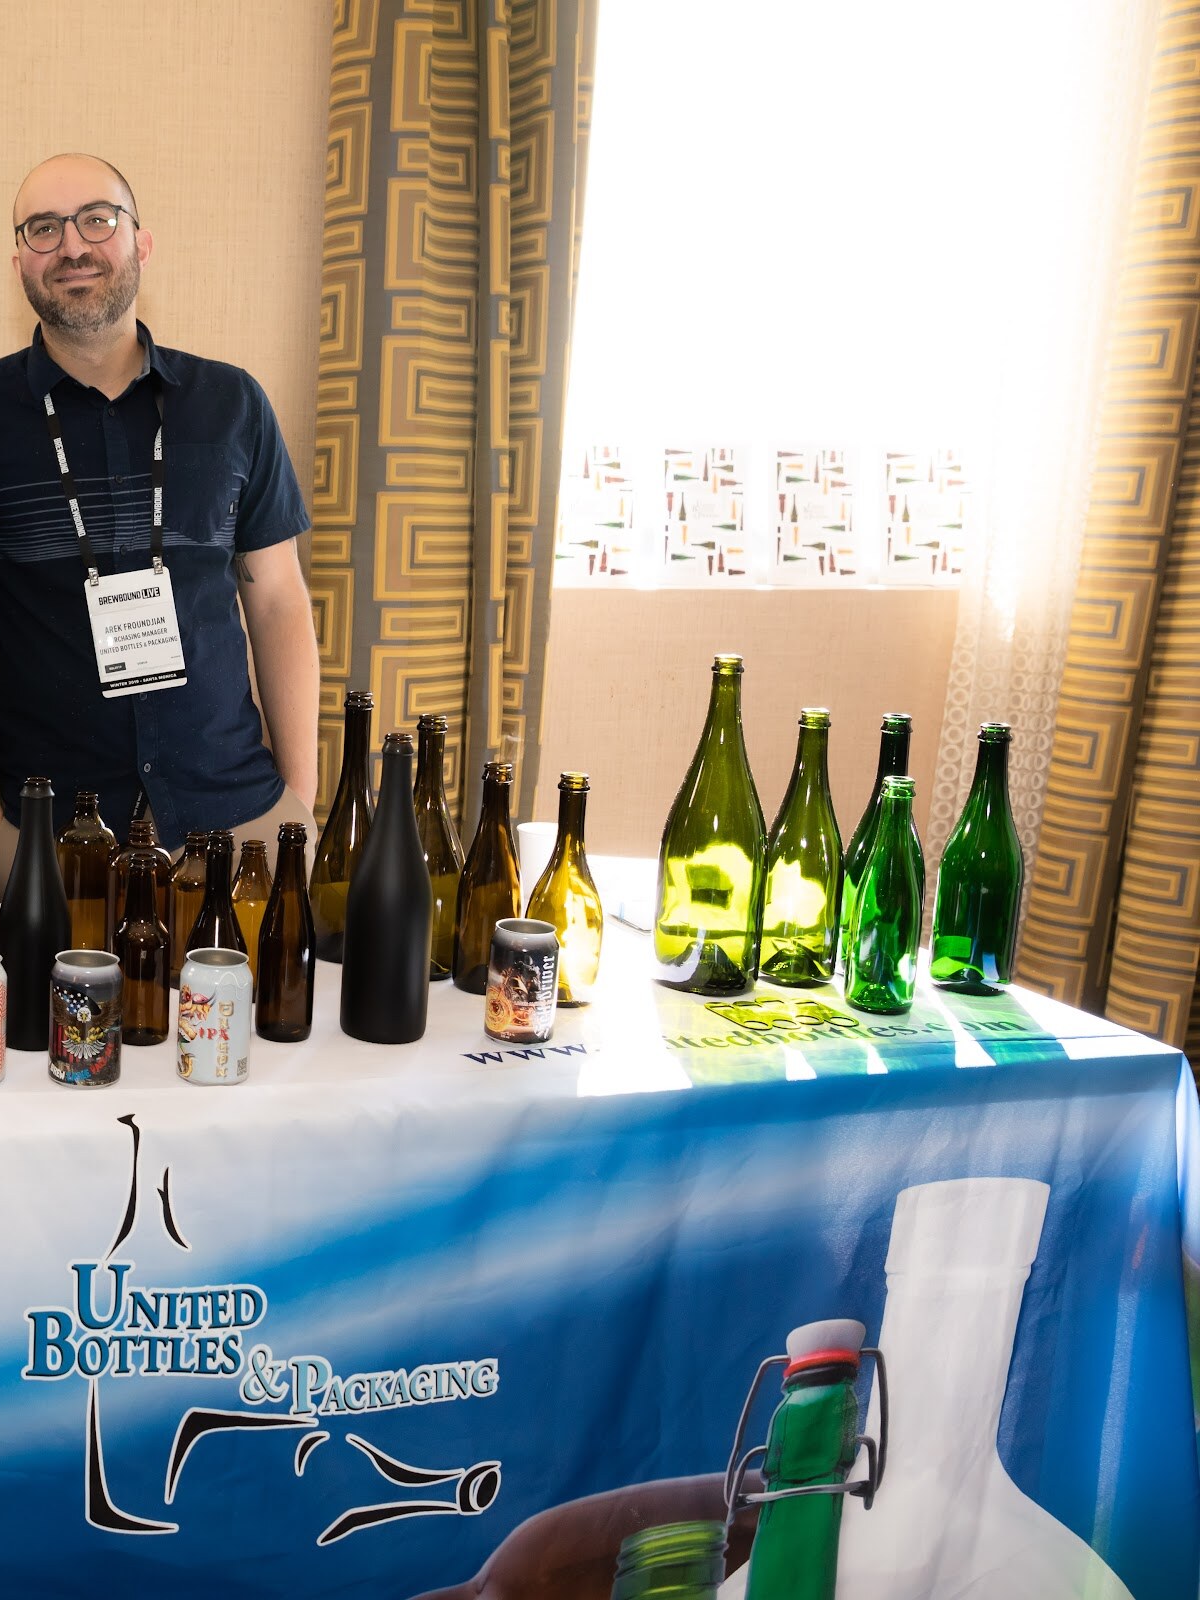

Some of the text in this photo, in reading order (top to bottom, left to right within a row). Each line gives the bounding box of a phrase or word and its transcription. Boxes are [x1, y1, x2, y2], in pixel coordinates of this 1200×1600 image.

[98, 587, 161, 606] BREWBOUND LIVE
[104, 616, 166, 634] AREK FROUNDJIAN
[141, 627, 168, 637] MANAGER
[99, 646, 120, 656] UNITED
[120, 641, 143, 652] BOTTLES
[147, 635, 178, 647] PACKAGING
[158, 673, 177, 681] MONICA
[198, 1027, 230, 1041] IPA
[70, 1262, 263, 1331] UNITED
[25, 1310, 243, 1378] BOTTLES
[244, 1349, 498, 1416] & PACKAGING
